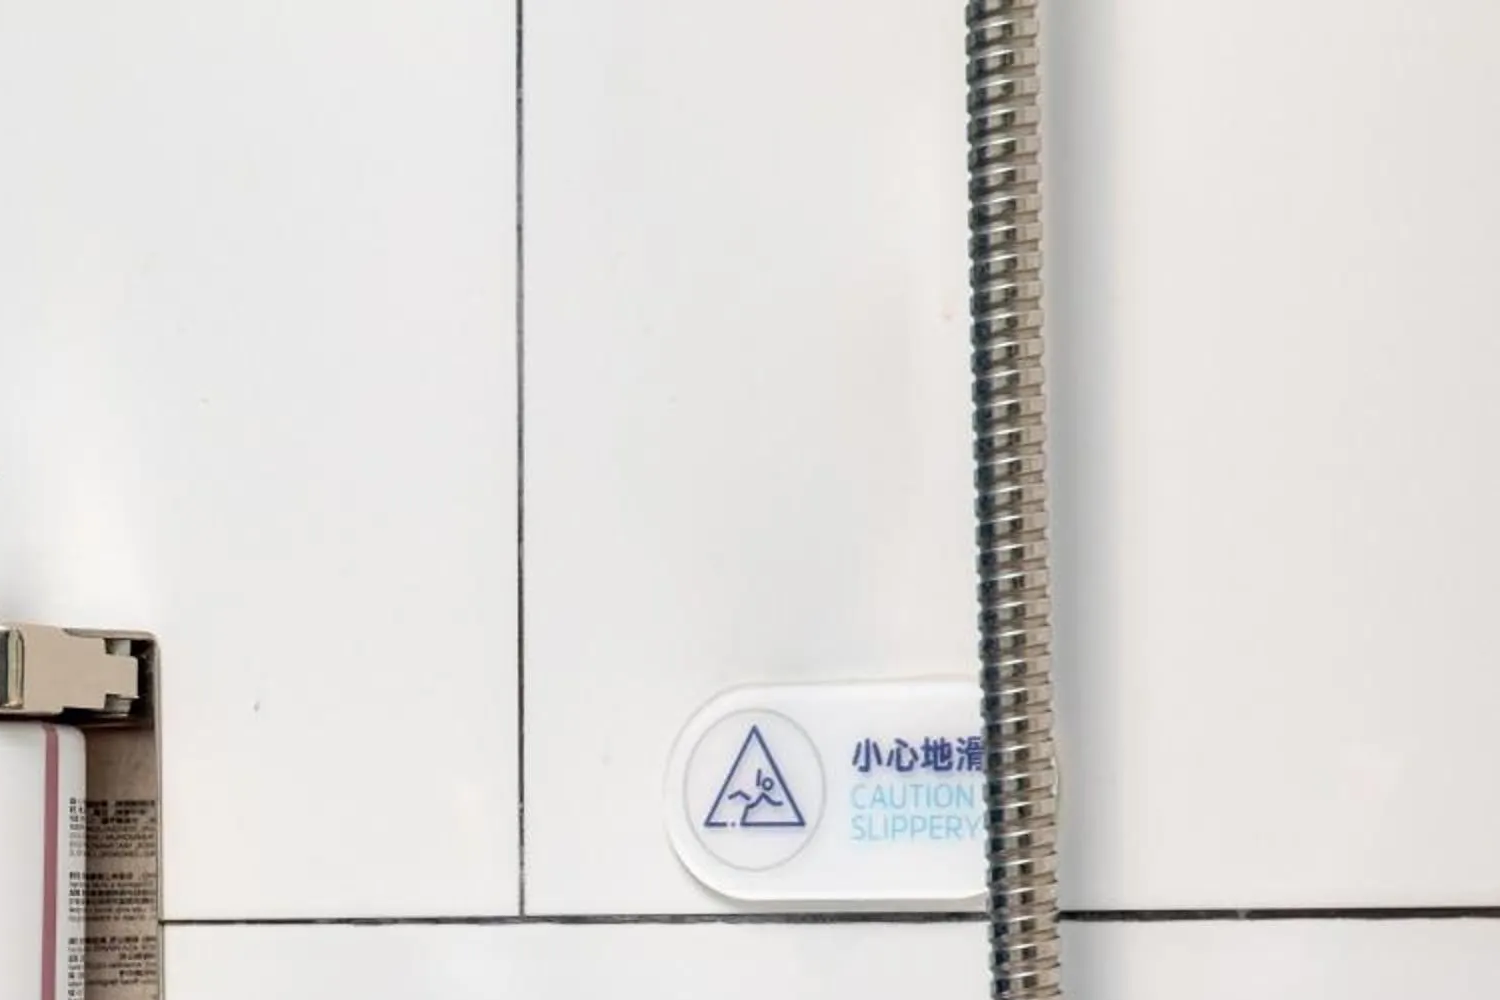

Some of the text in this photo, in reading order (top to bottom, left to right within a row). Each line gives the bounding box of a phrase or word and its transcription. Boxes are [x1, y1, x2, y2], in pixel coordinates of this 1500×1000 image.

[851, 736, 986, 774] 小心地滑
[850, 783, 975, 810] CAUTION
[850, 814, 984, 841] SLIPPERY
